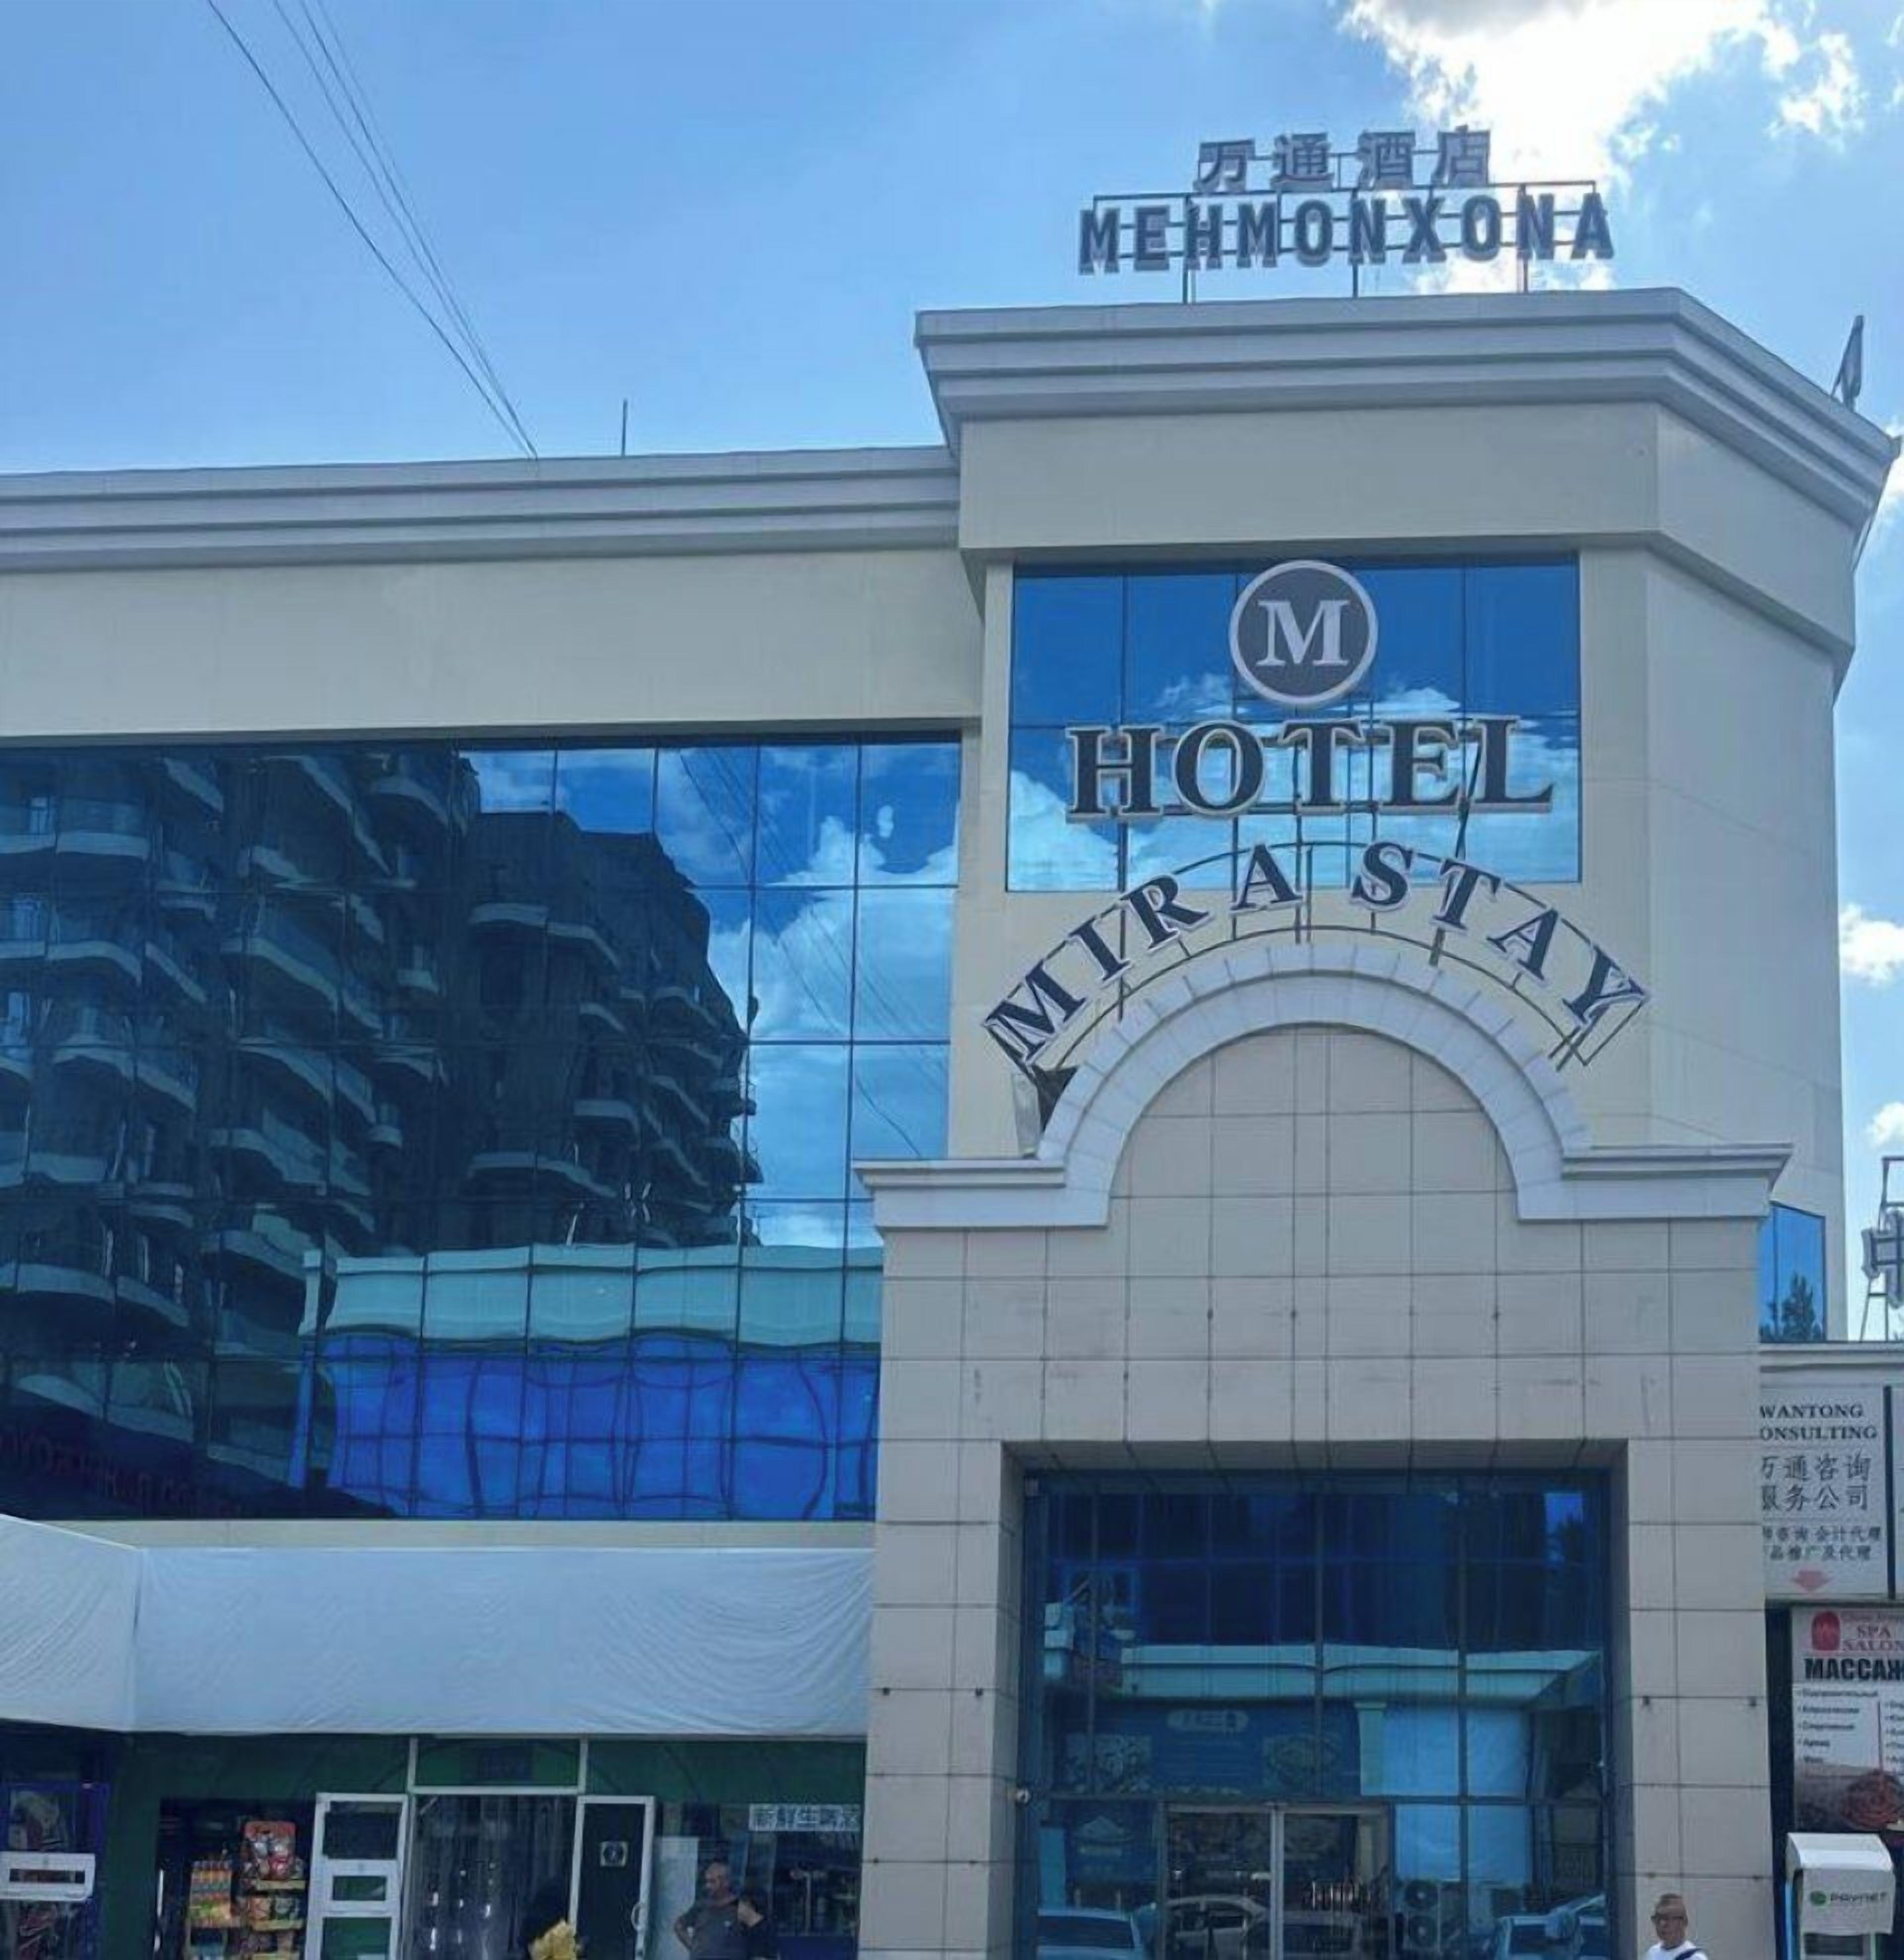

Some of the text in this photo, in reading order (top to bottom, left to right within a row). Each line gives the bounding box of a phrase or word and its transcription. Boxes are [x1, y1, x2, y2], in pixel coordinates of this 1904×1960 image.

[1194, 125, 1491, 193] 万通酒店
[1078, 192, 1614, 274] MEHMONXONA
[1256, 598, 1351, 667] M
[1066, 717, 1555, 822] HOTEL
[982, 841, 1650, 1065] MIRA STAY
[1760, 1405, 1863, 1418] WANTONG
[1857, 1625, 1891, 1638] SPA
